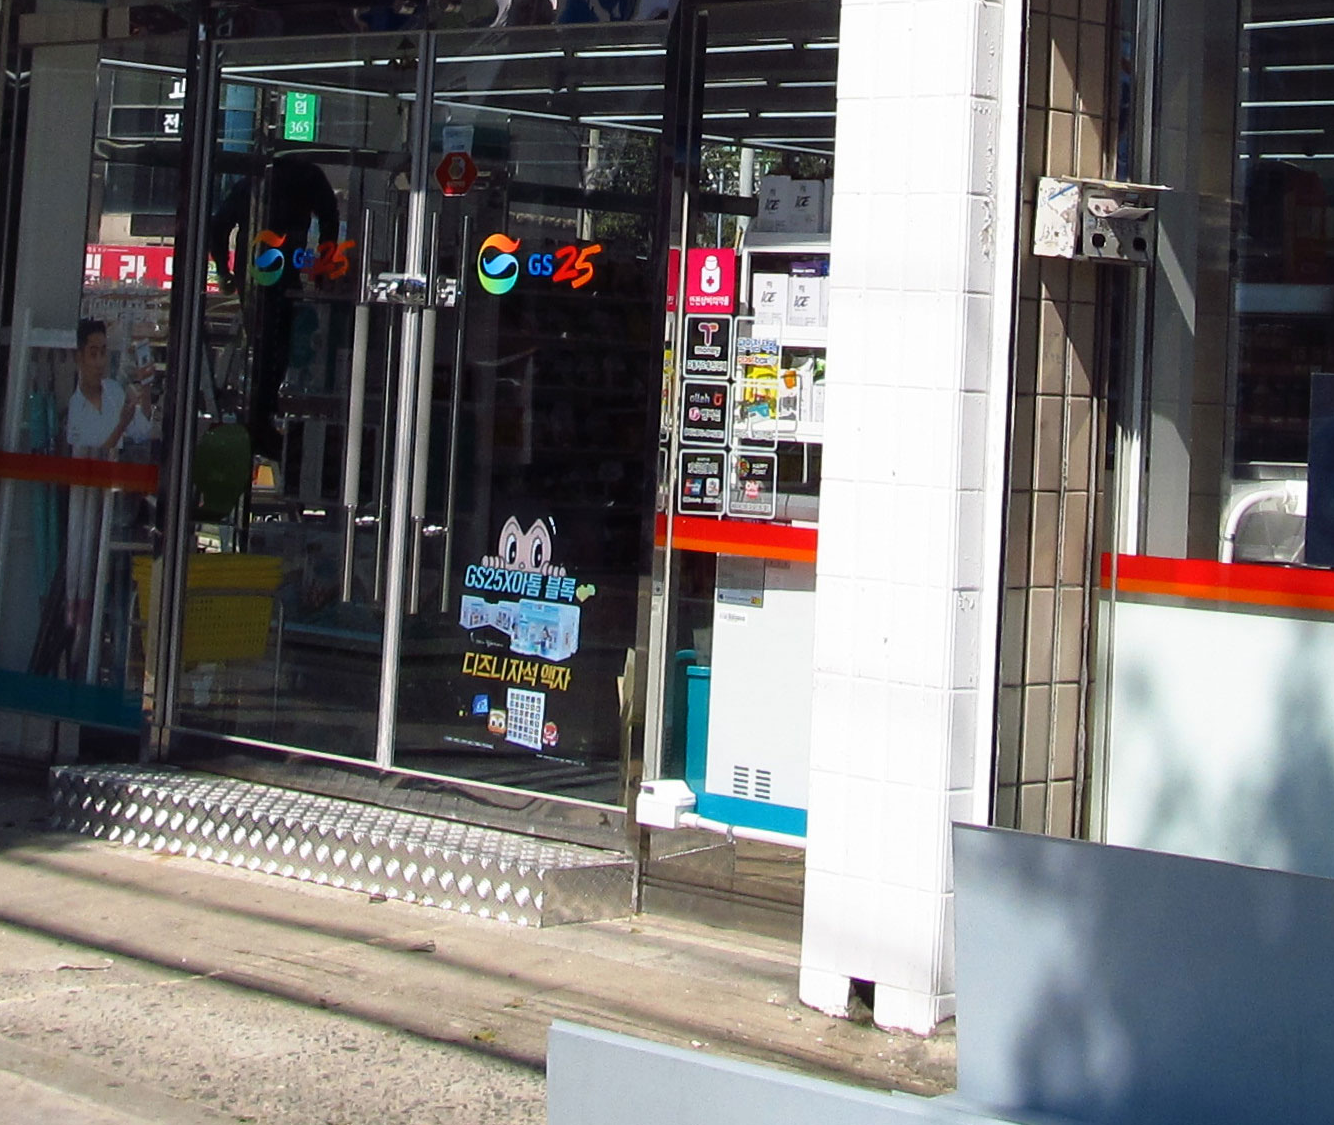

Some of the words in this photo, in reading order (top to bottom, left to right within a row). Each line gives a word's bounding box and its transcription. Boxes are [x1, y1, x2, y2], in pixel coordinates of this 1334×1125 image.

[289, 121, 310, 134] 365
[292, 239, 356, 279] GS25
[527, 243, 602, 289] GS25
[540, 664, 572, 691] 액자
